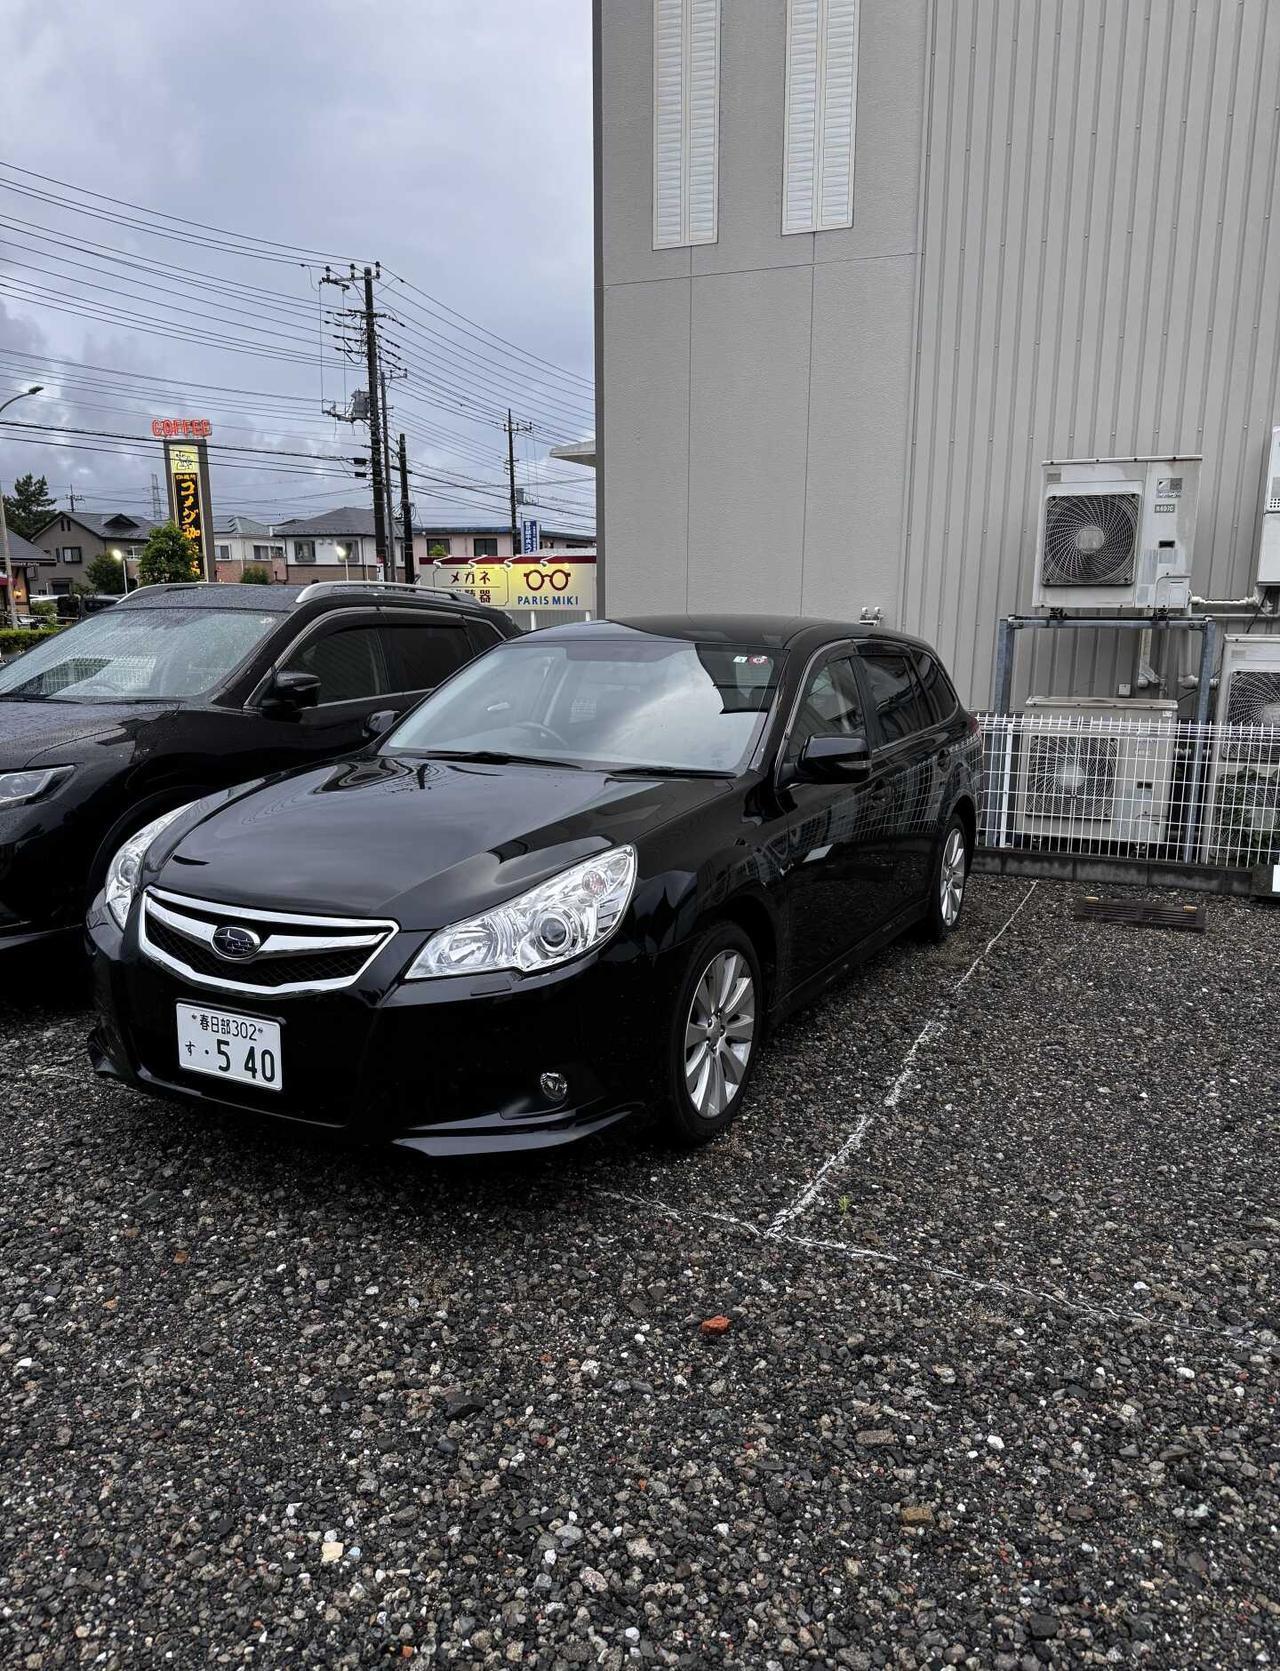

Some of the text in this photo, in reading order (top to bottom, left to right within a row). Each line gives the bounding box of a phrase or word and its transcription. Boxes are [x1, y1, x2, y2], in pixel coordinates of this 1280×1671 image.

[152, 419, 212, 436] COFFEE
[451, 571, 491, 584] メガネ
[517, 595, 579, 605] PARIS MIKI
[185, 1040, 196, 1056] す
